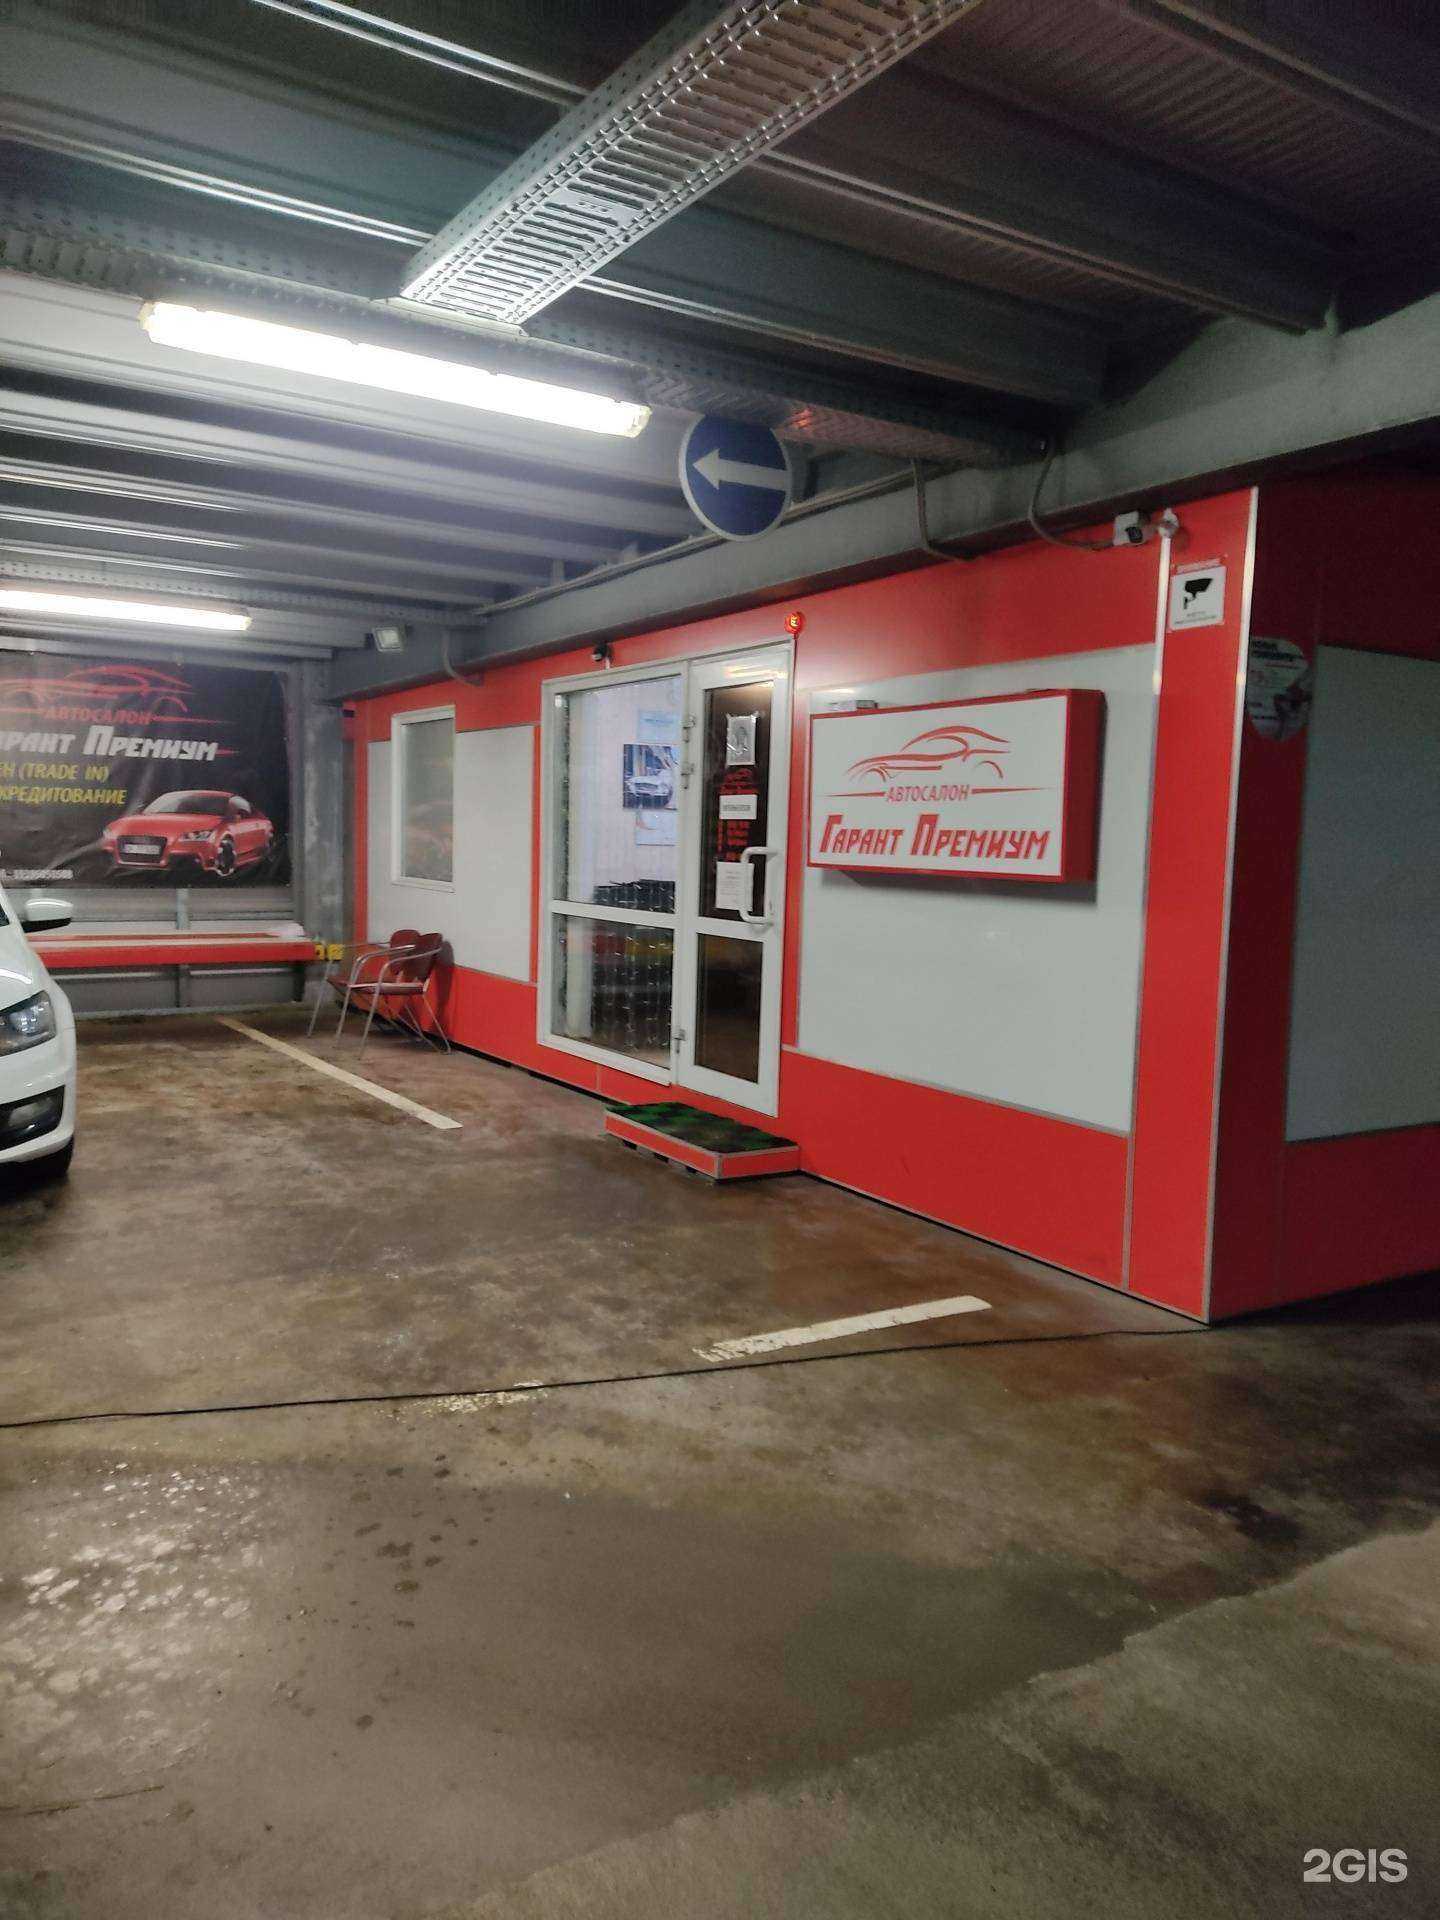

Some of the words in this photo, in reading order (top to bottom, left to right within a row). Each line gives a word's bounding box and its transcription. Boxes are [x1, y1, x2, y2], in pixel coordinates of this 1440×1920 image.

[43, 705, 151, 725] АВТОСАЛОН
[82, 725, 219, 761] ПРЕМИУМ
[19, 762, 79, 781] (TRADE
[885, 784, 971, 803] АВТОСАЛОН
[819, 814, 904, 856] ГАРАНТ
[910, 813, 1050, 860] ПРЕМИУМ
